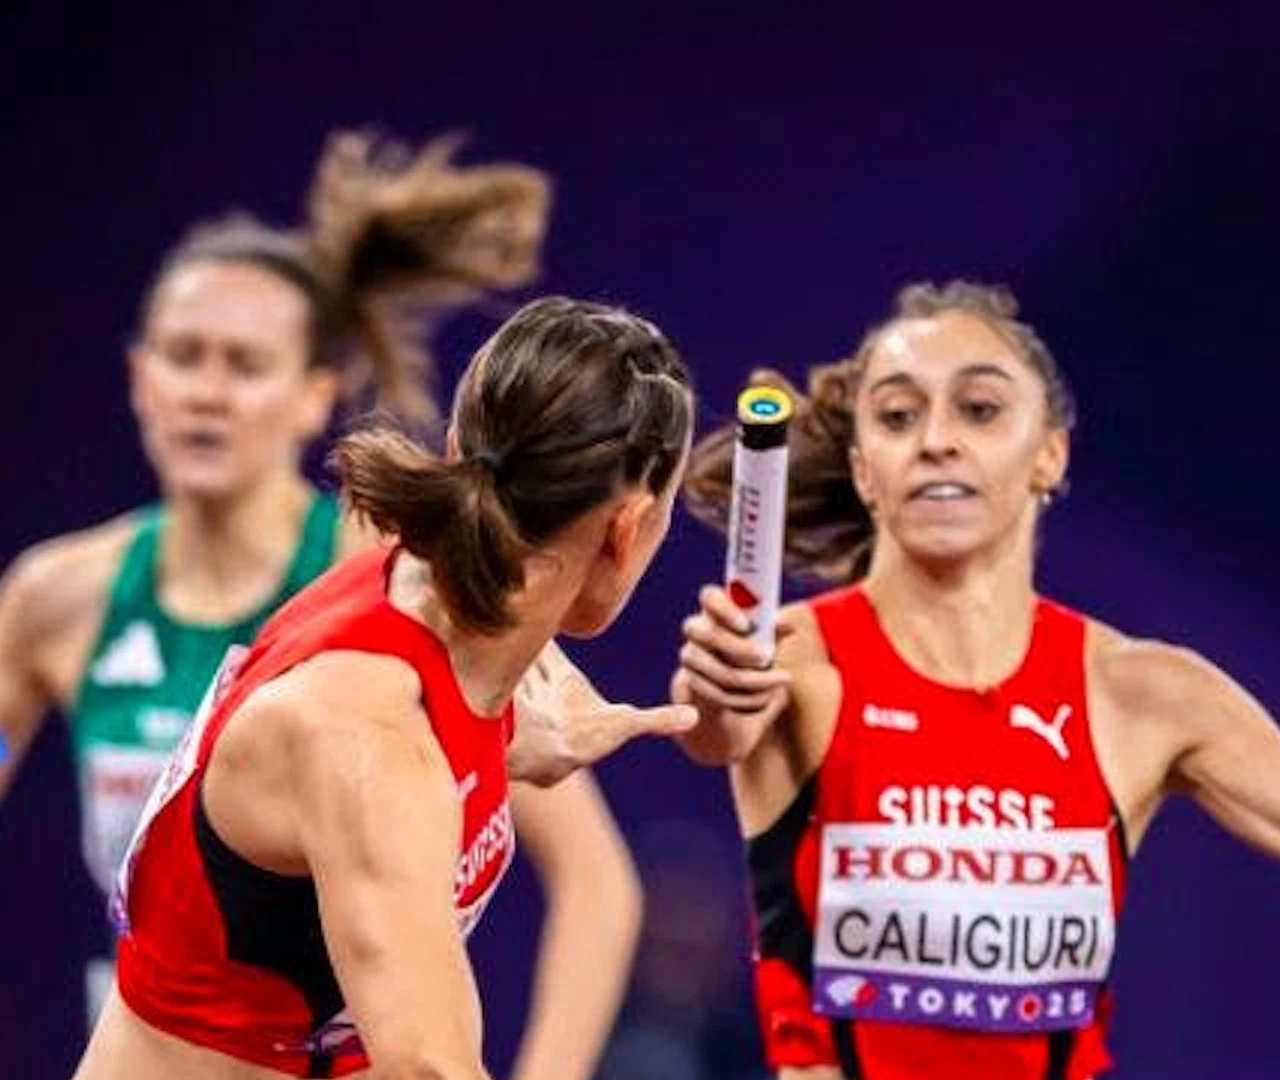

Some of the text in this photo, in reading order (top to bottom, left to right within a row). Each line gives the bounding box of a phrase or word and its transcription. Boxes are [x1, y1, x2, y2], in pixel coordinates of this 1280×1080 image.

[878, 785, 1056, 830] SUISSE
[831, 845, 1102, 887] HONDA
[833, 908, 1100, 972] CALIGIURI
